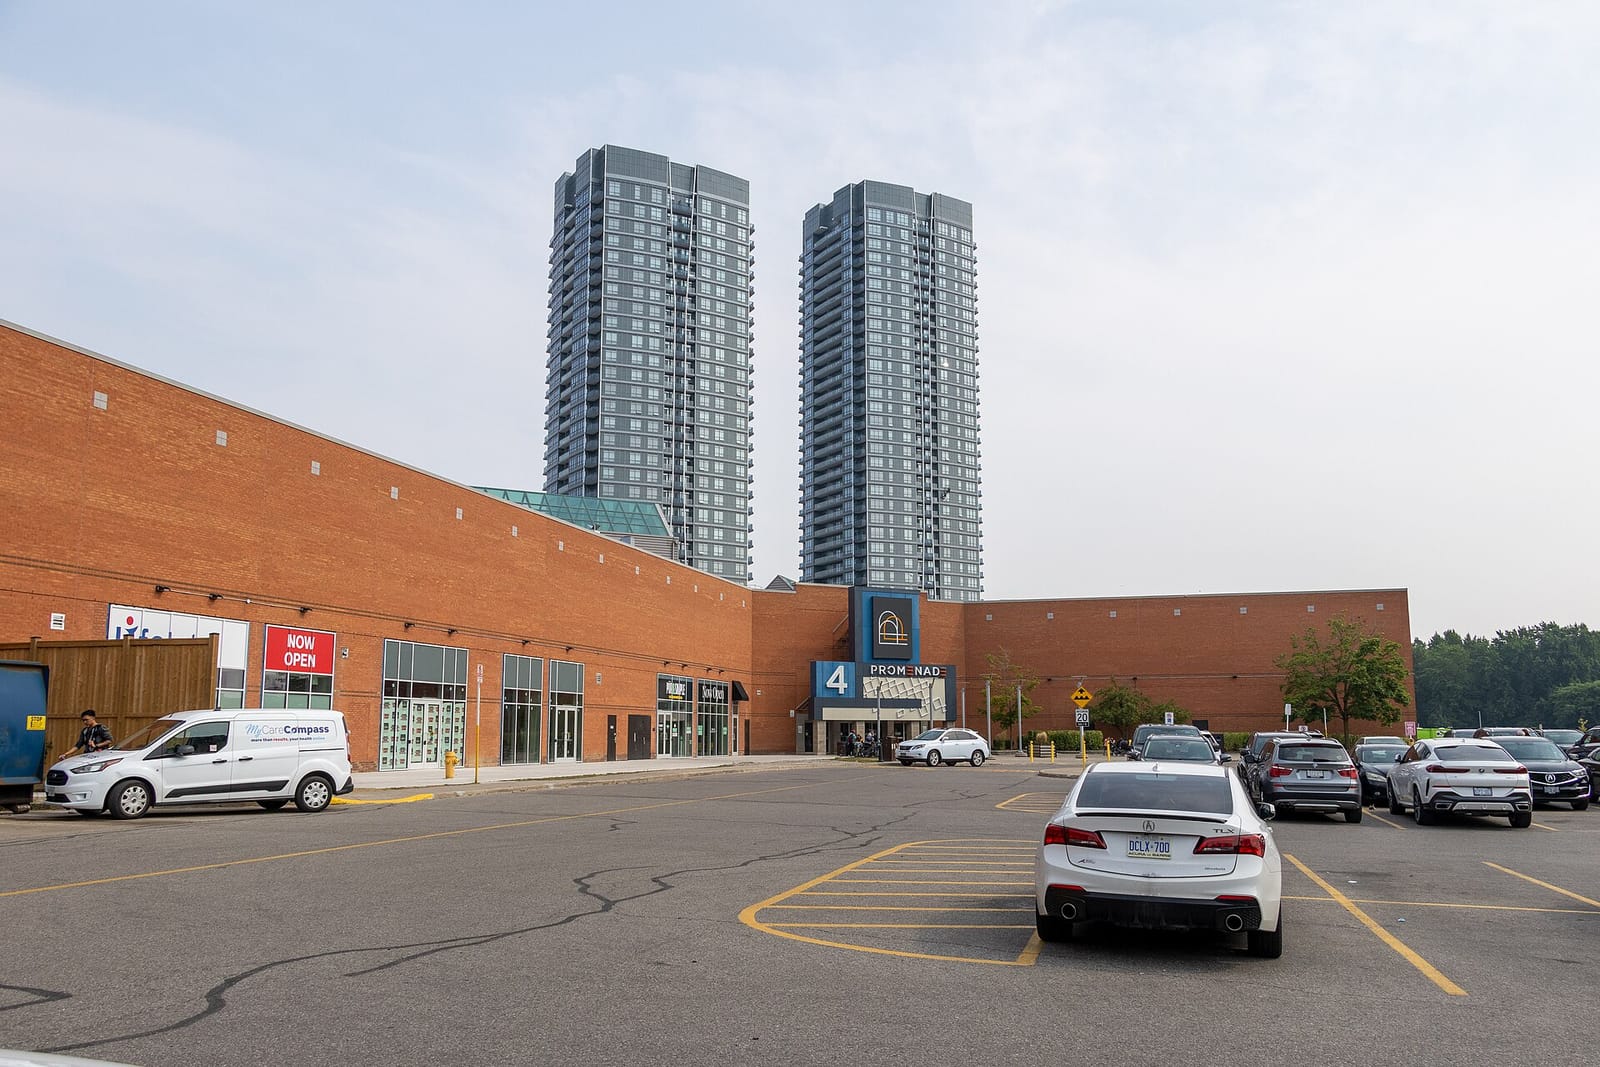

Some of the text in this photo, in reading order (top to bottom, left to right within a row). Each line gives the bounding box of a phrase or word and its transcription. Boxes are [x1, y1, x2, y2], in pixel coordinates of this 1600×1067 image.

[287, 634, 315, 650] NOW
[284, 652, 316, 668] OPEN
[870, 664, 947, 678] PROMENADE
[826, 665, 848, 695] 4
[1077, 713, 1088, 722] 20
